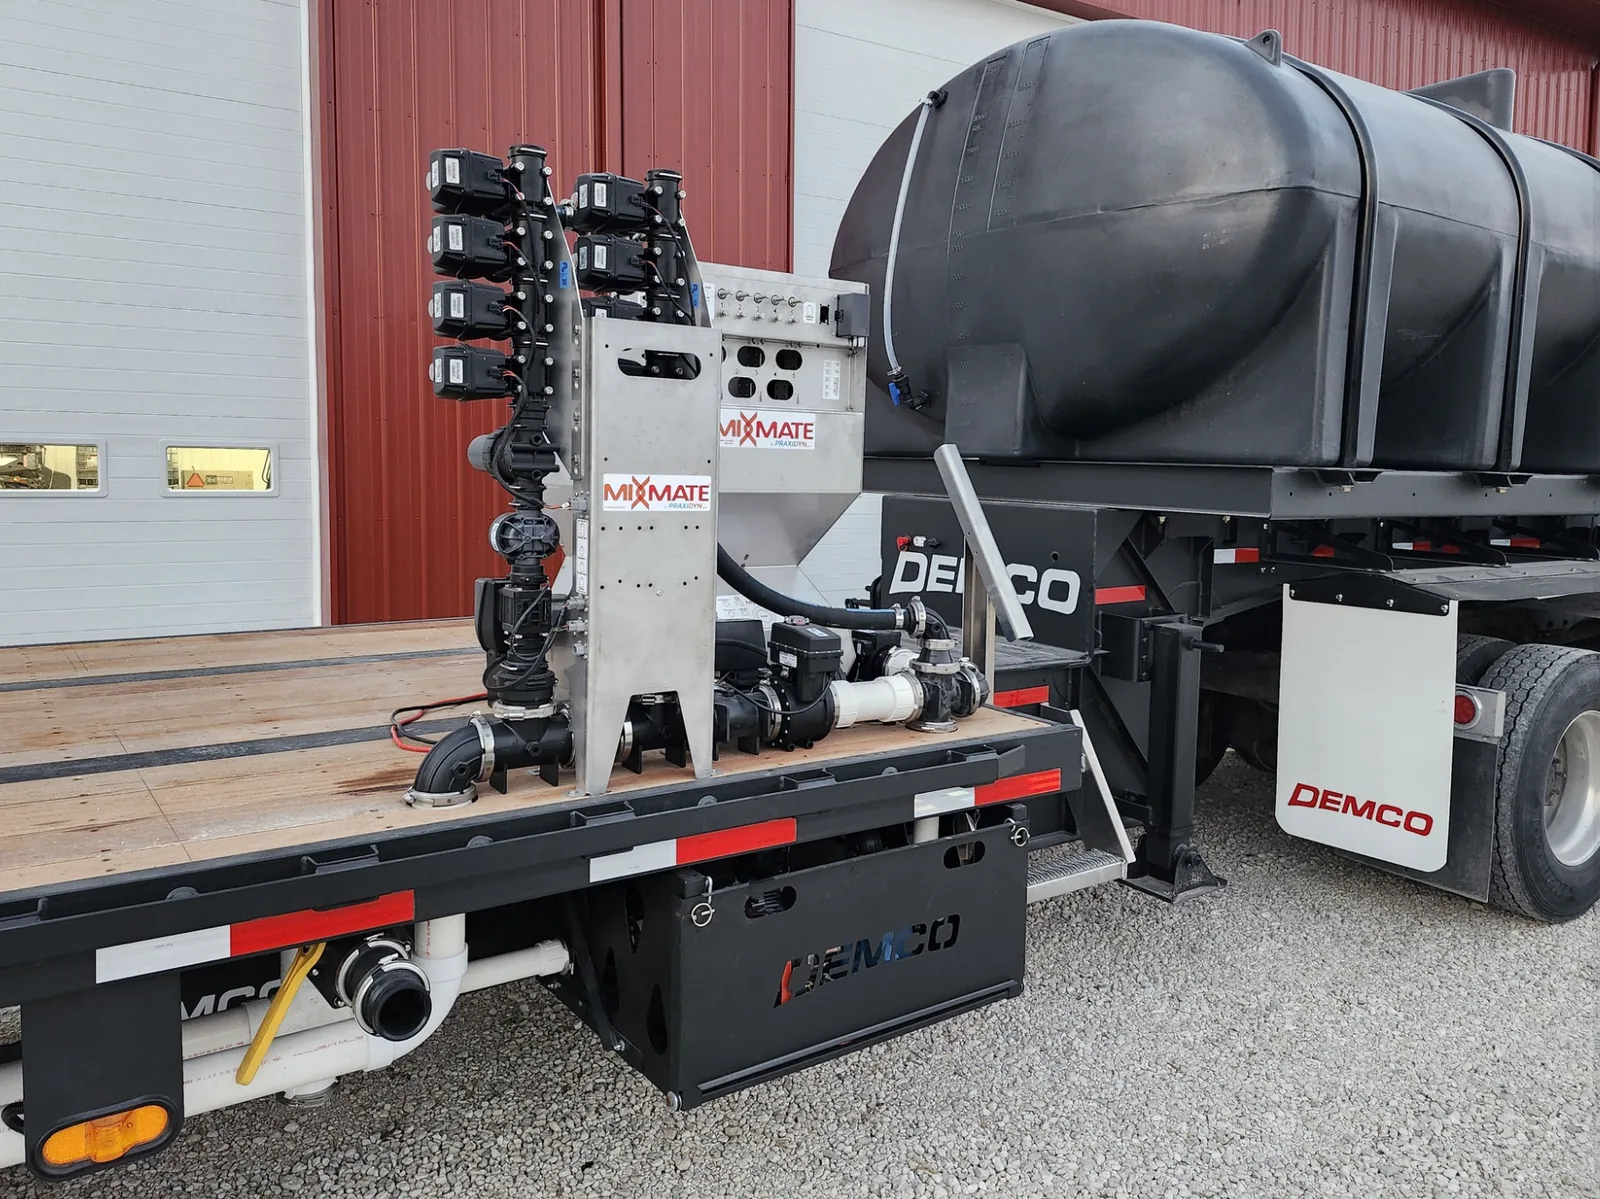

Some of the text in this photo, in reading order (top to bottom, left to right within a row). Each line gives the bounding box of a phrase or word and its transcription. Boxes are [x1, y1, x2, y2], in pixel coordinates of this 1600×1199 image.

[603, 475, 710, 511] MIXMATE
[888, 551, 1081, 615] DECO
[1288, 782, 1434, 837] DEMCO
[773, 914, 961, 1009] DEMCO
